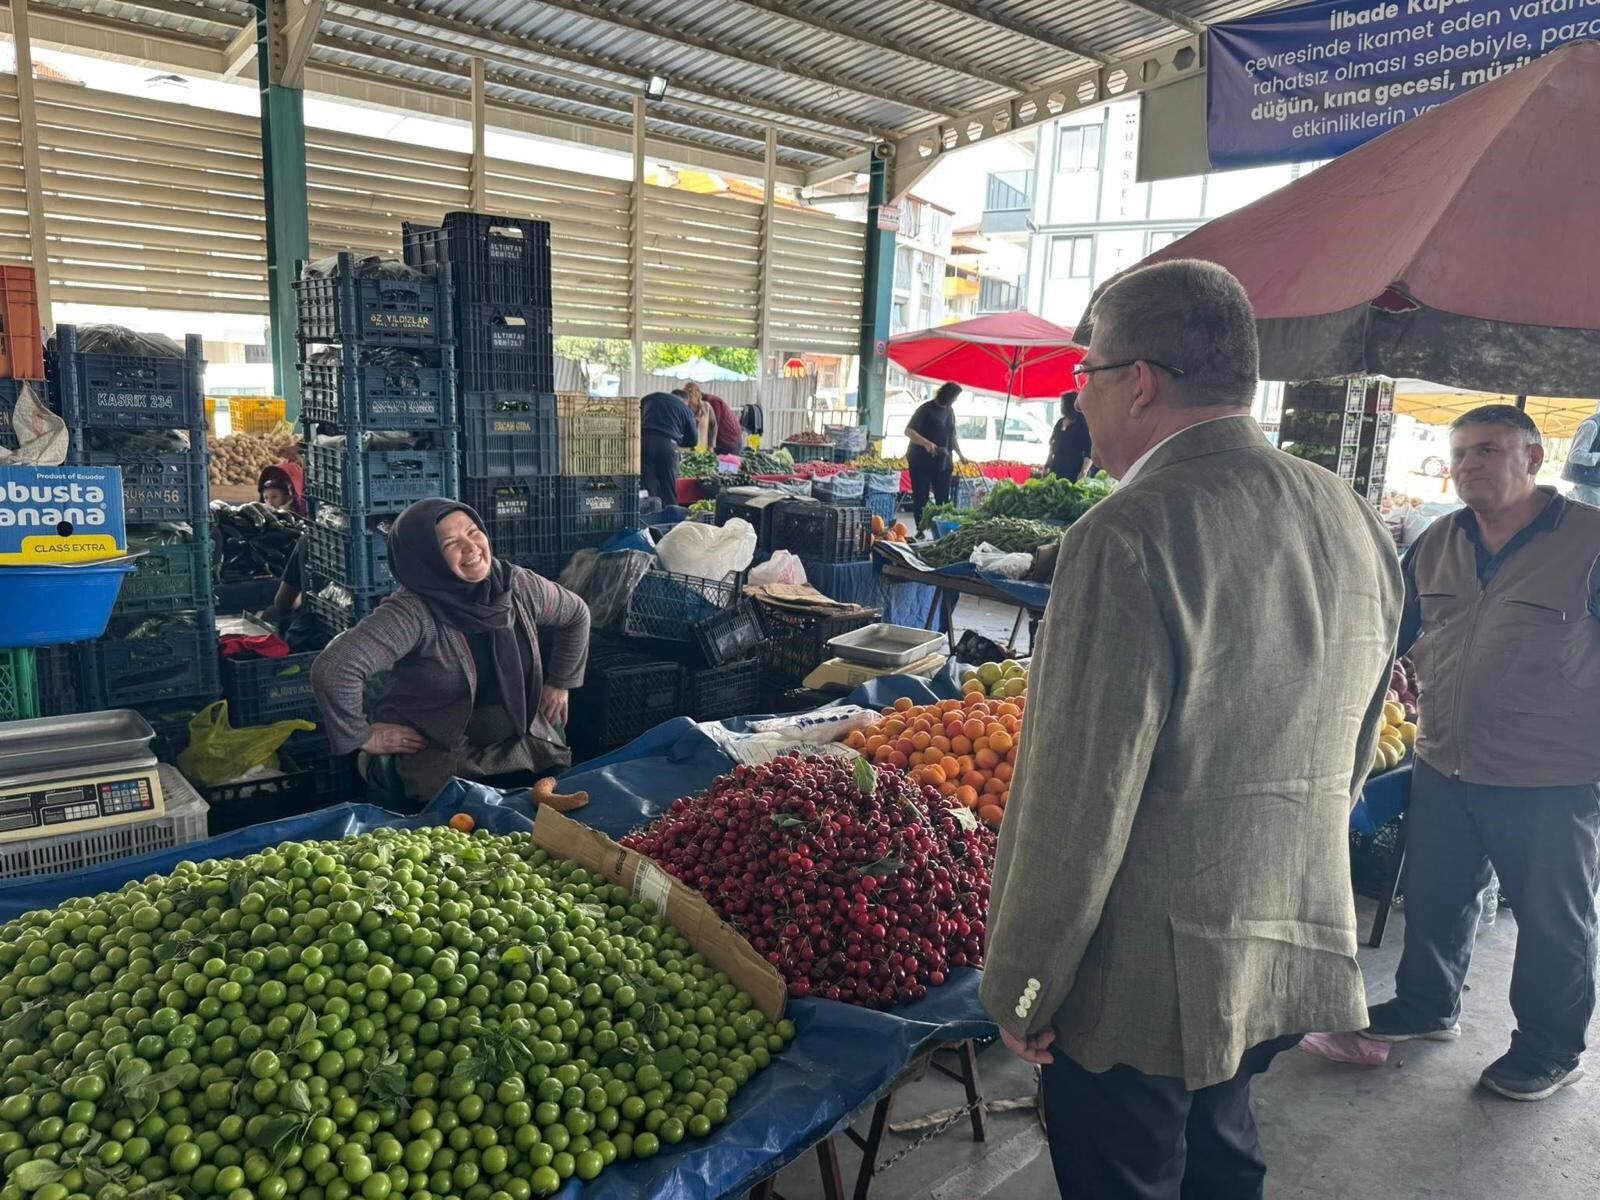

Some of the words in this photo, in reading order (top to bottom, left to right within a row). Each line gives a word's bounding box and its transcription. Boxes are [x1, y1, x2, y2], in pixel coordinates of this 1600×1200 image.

[1244, 39, 1351, 78] çevresinde
[1357, 21, 1434, 51] ikamet
[1441, 10, 1500, 35] eden
[1509, 0, 1600, 21] vatan
[1253, 70, 1328, 96] rahatsız
[1335, 57, 1406, 81] olması
[1413, 31, 1532, 67] sebebiyle,
[1251, 97, 1319, 122] düğün,
[1324, 88, 1370, 110] kına
[1375, 69, 1455, 106] gecesi,
[1292, 107, 1406, 139] etkinliklerin
[150, 395, 173, 409] 234
[36, 472, 66, 480] Product
[67, 472, 76, 480] of
[77, 473, 105, 481] Ecuador
[163, 489, 179, 503] 56
[34, 544, 70, 553] CLASS
[72, 543, 106, 552] EXTRA
